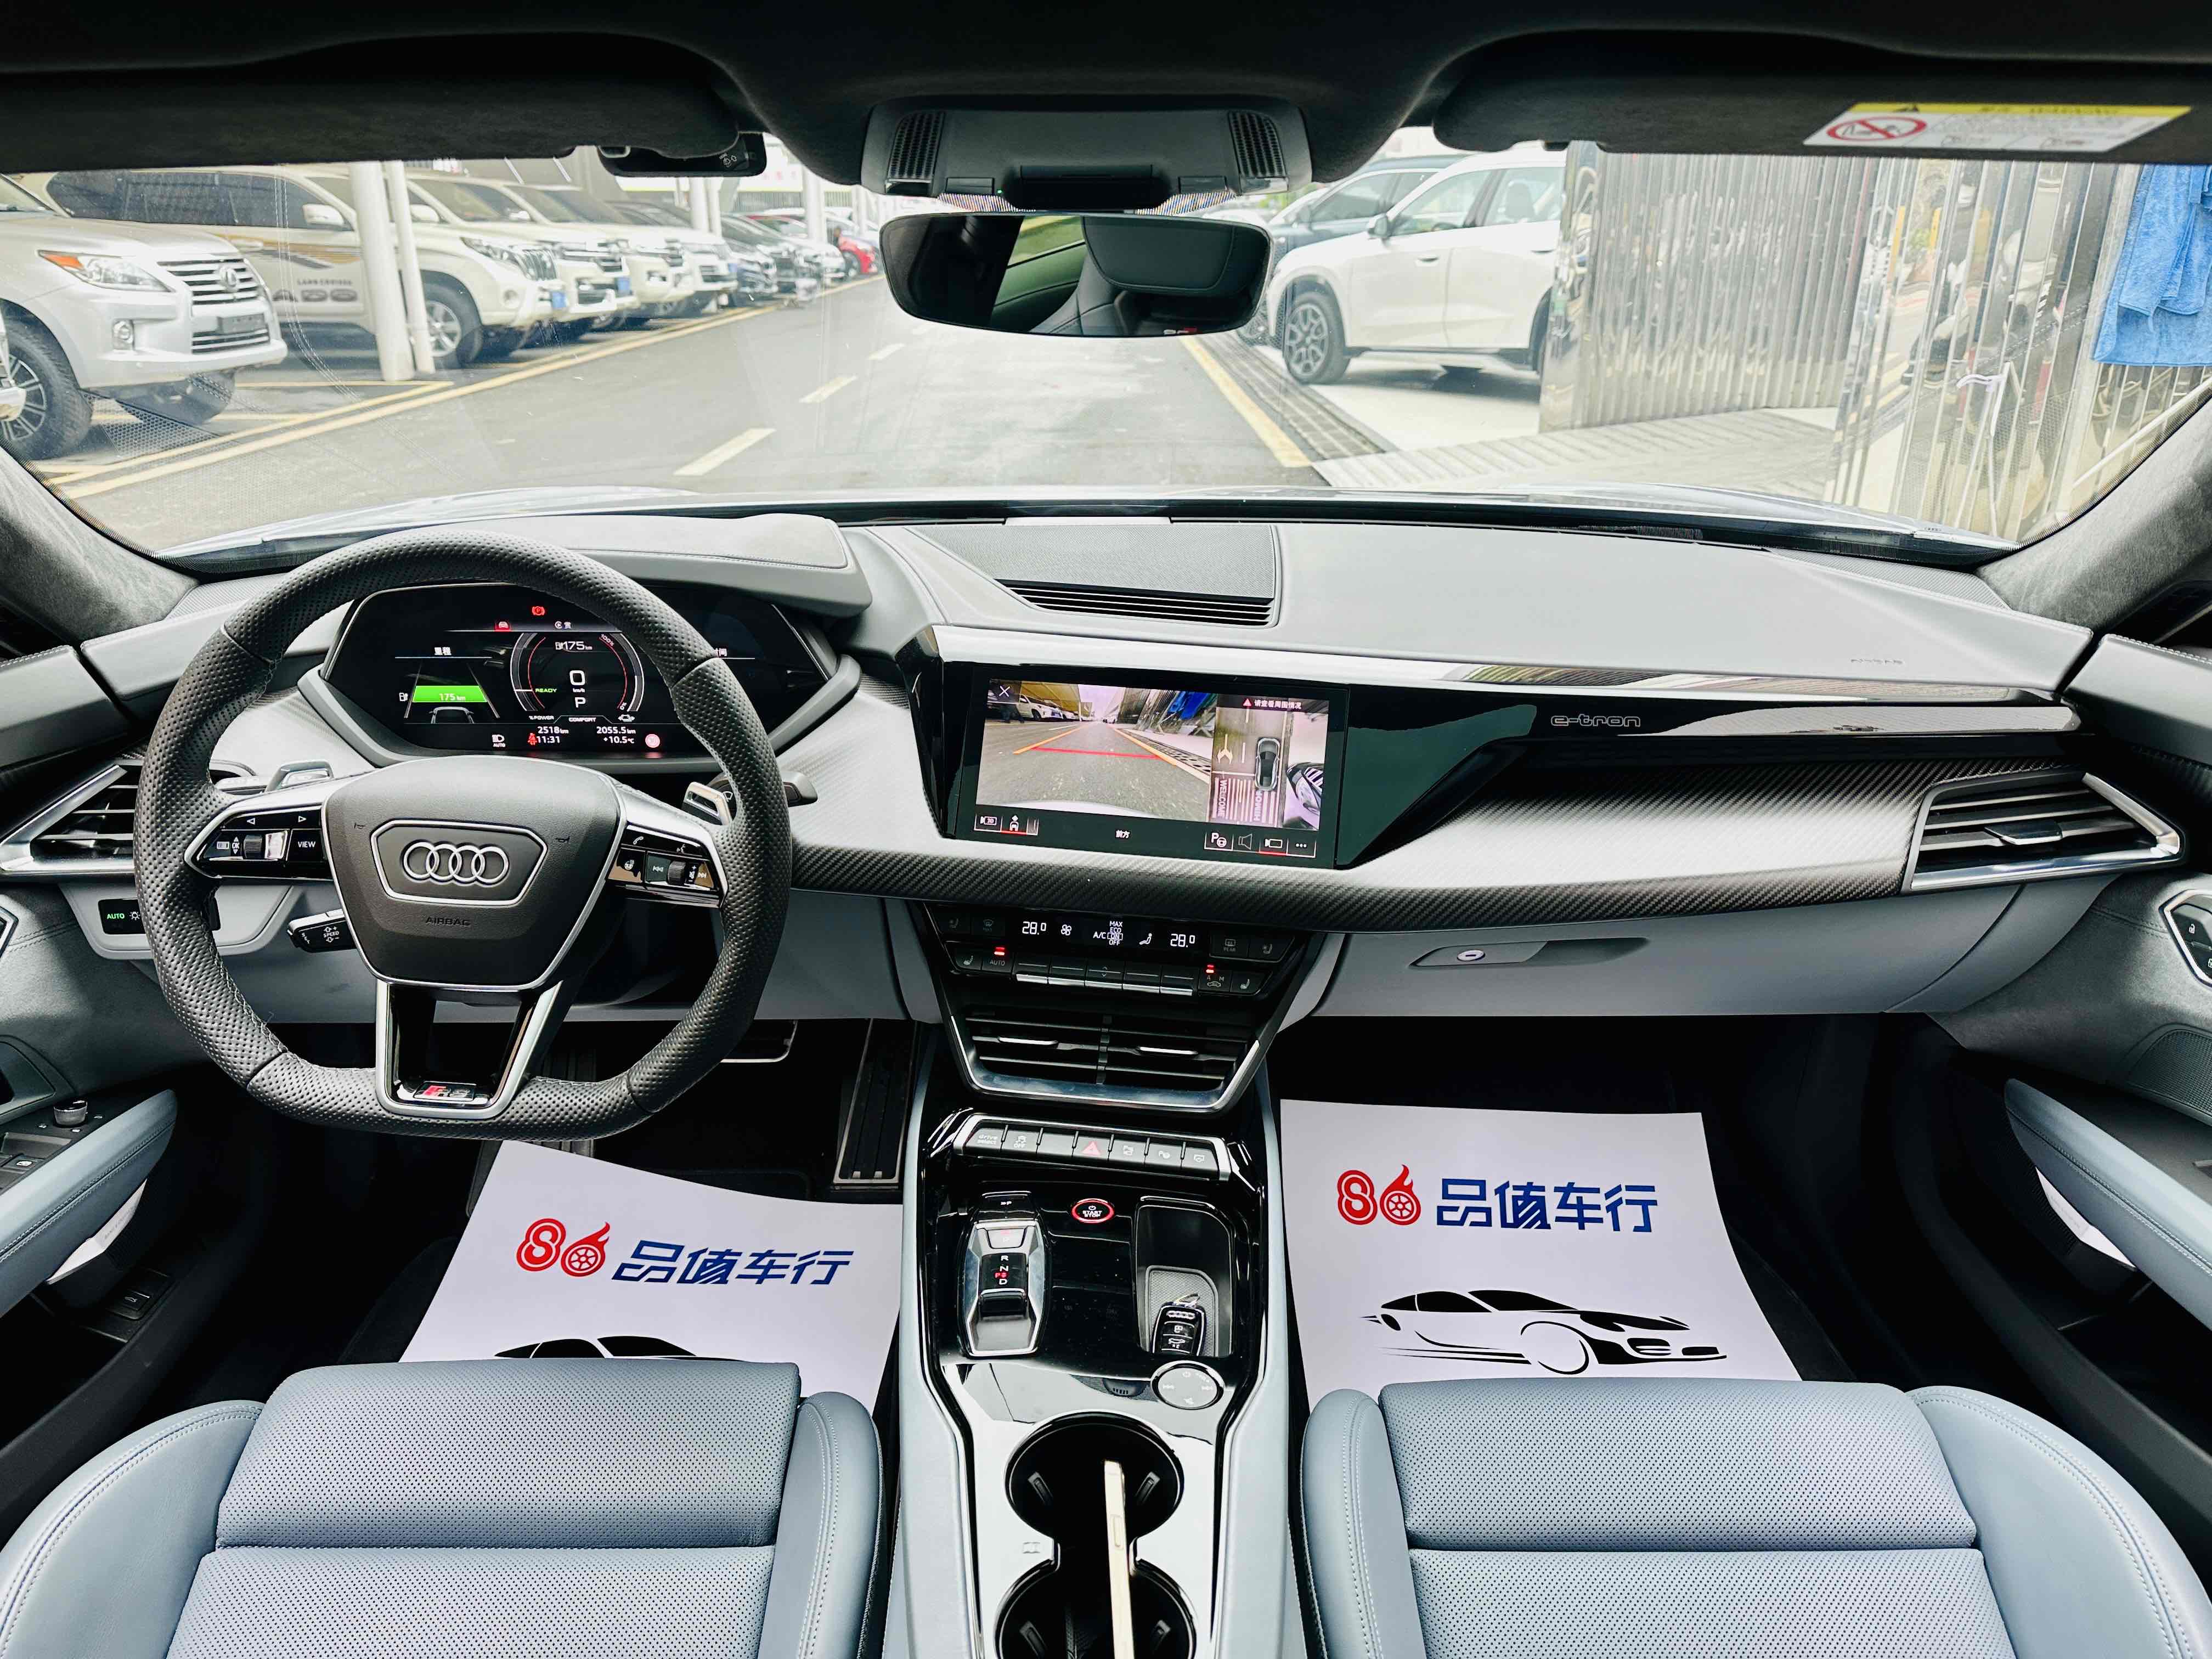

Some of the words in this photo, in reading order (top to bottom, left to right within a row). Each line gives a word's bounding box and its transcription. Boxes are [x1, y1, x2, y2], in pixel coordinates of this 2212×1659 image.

[574, 697, 586, 708] P
[1550, 714, 1640, 727] e-tron
[425, 917, 471, 926] AIRBAG
[1093, 932, 1107, 940] A/C
[1436, 1178, 1658, 1233] 品值车行
[611, 1240, 854, 1285] 品值车行
